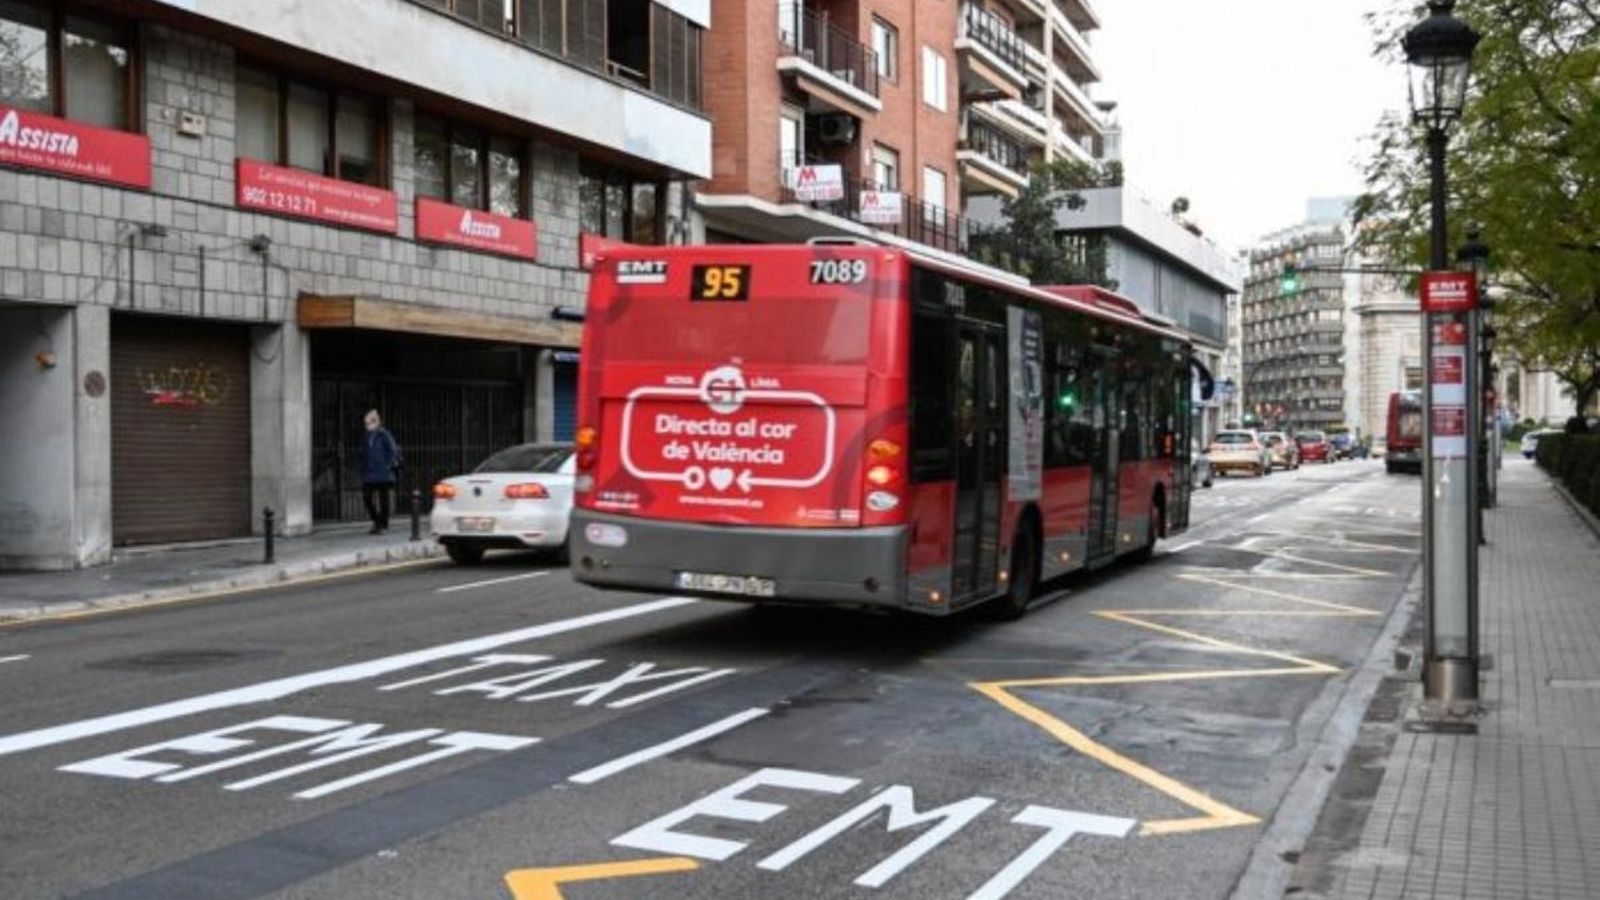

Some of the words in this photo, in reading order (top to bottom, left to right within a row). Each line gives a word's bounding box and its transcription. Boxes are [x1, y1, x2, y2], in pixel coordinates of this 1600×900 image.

[0, 110, 79, 156] ASSISTA
[270, 192, 285, 208] 12
[287, 195, 301, 210] 12
[303, 198, 317, 215] 71
[617, 261, 667, 273] EMT
[810, 259, 867, 284] 7089
[703, 267, 741, 297] 95
[655, 413, 732, 436] Directa
[735, 418, 757, 437] al
[760, 423, 798, 440] cor
[661, 441, 690, 460] de
[379, 654, 737, 709] TAXI
[56, 715, 543, 799] EMT
[609, 767, 1140, 900] EMT
